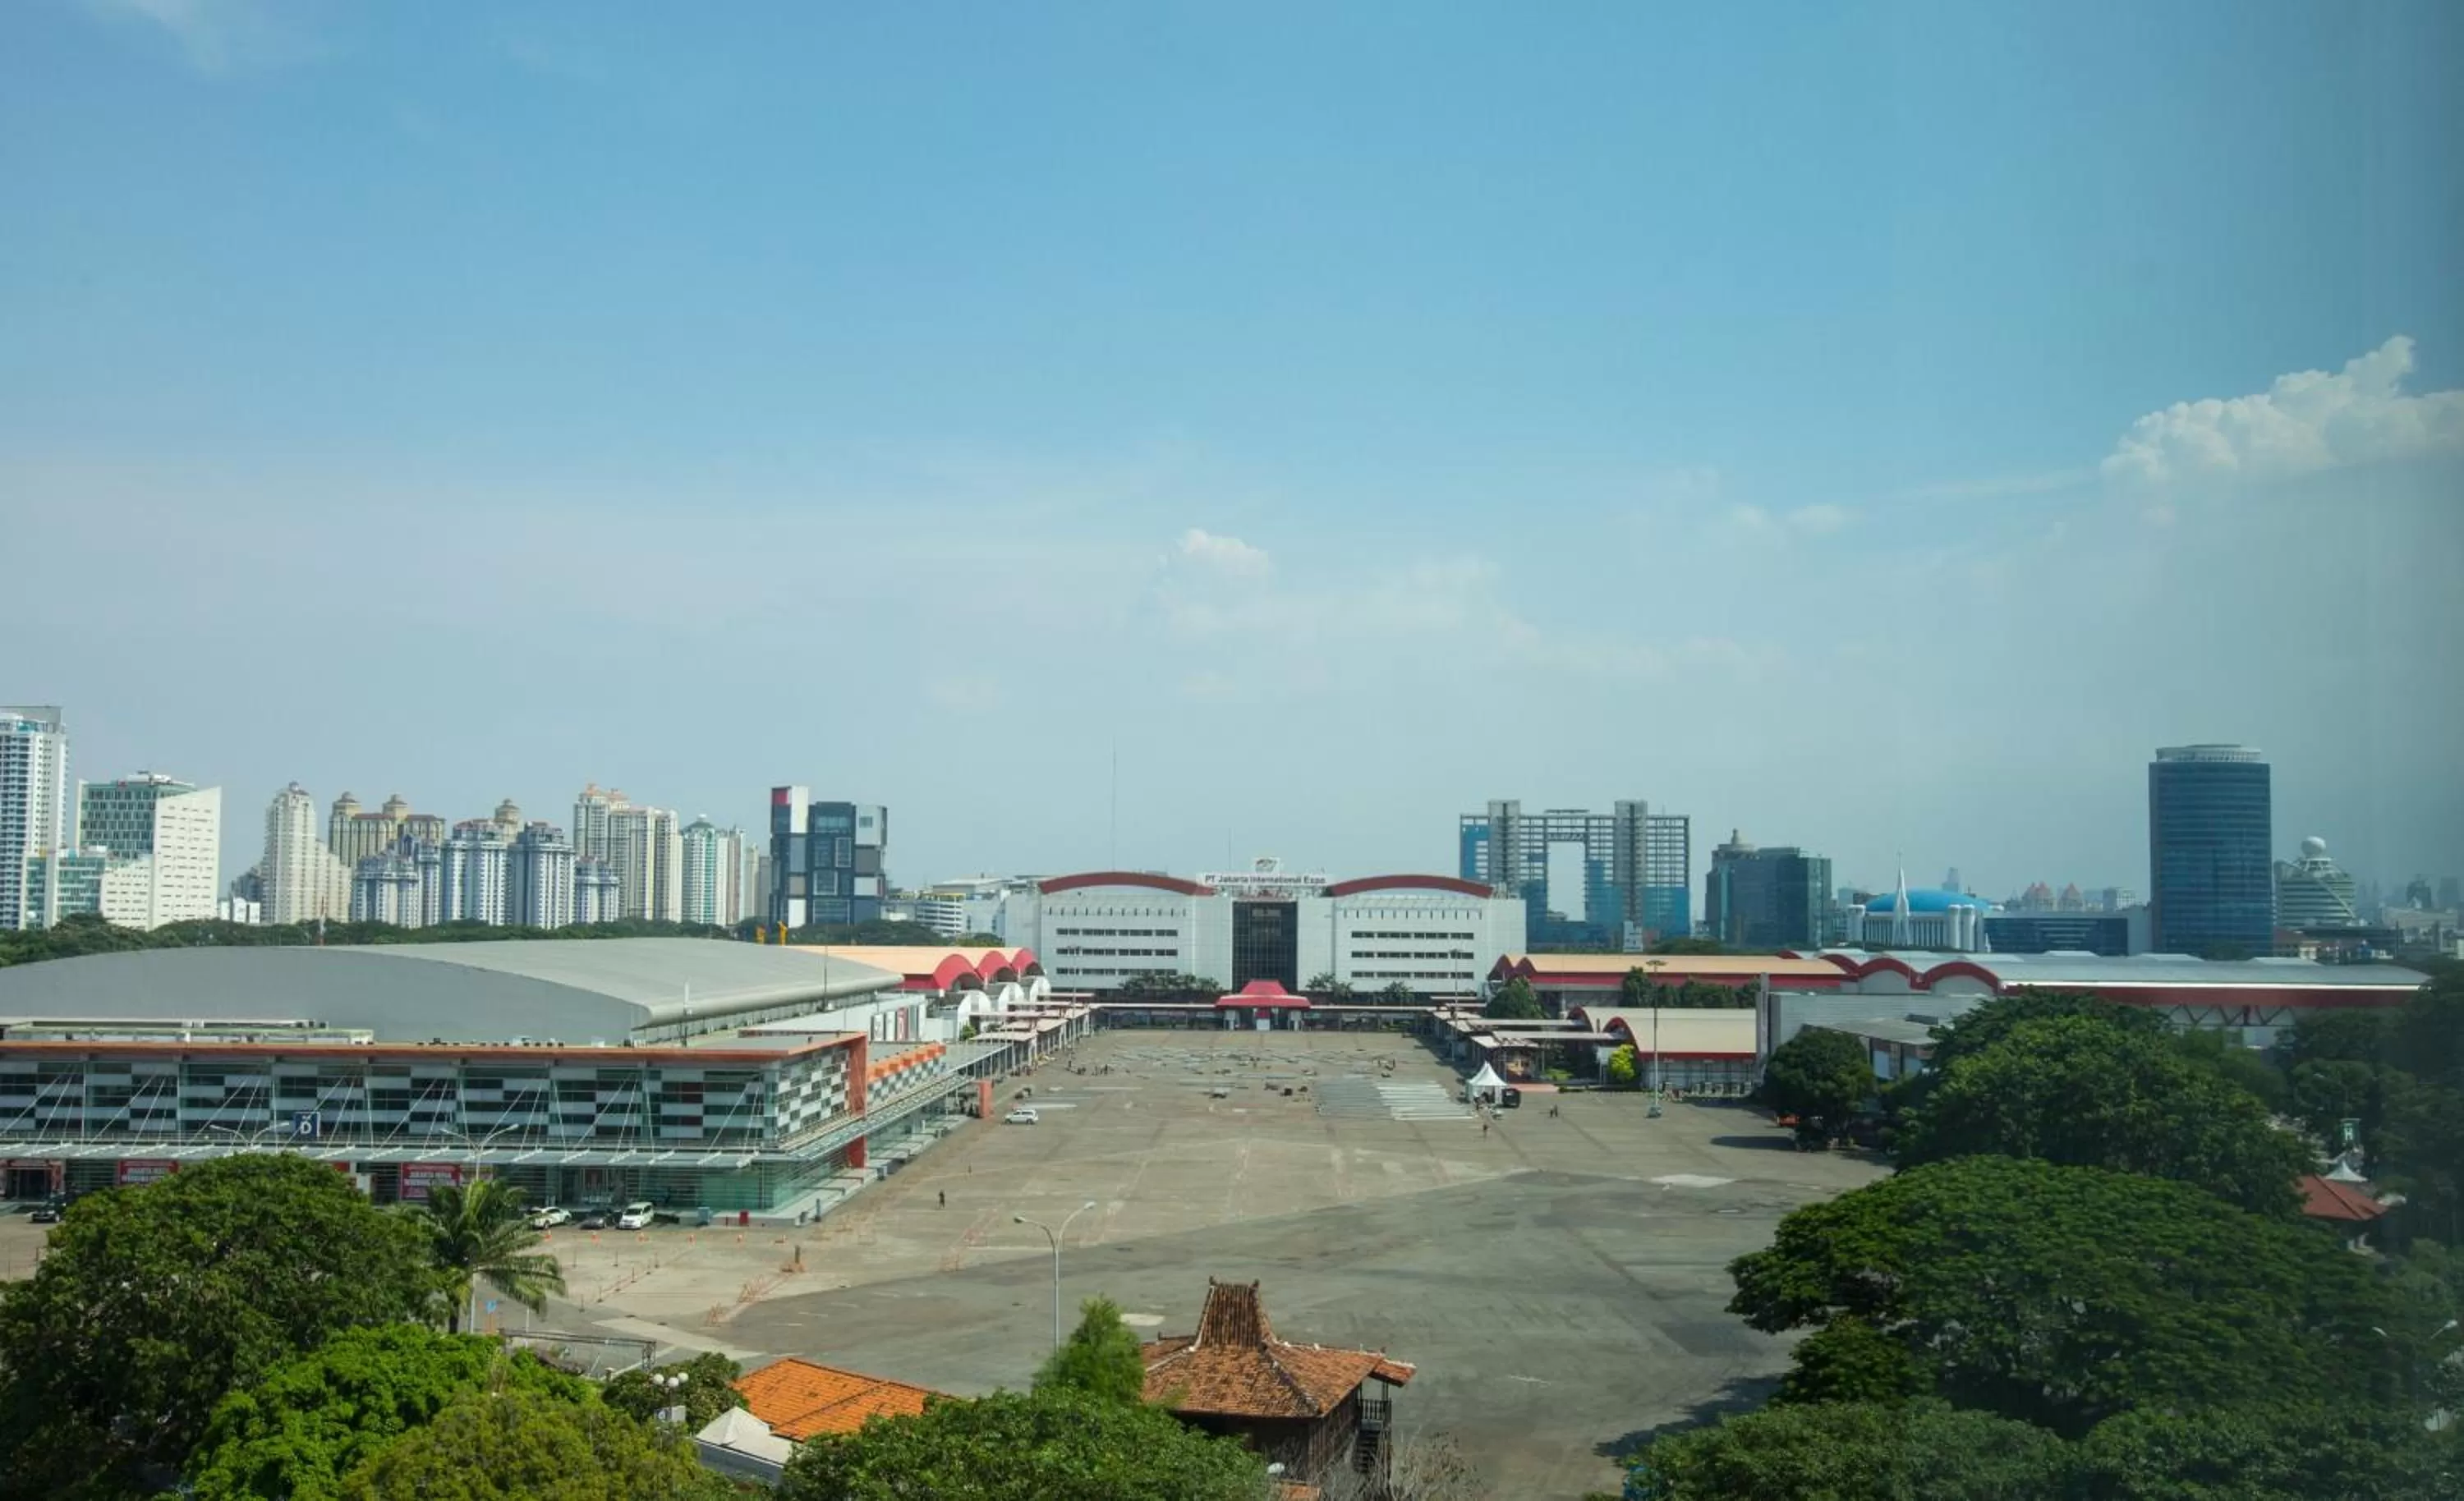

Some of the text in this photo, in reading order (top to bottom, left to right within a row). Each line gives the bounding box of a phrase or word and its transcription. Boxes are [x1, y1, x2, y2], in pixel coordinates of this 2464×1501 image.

[1205, 874, 1326, 885] PT Jakarta International Expo
